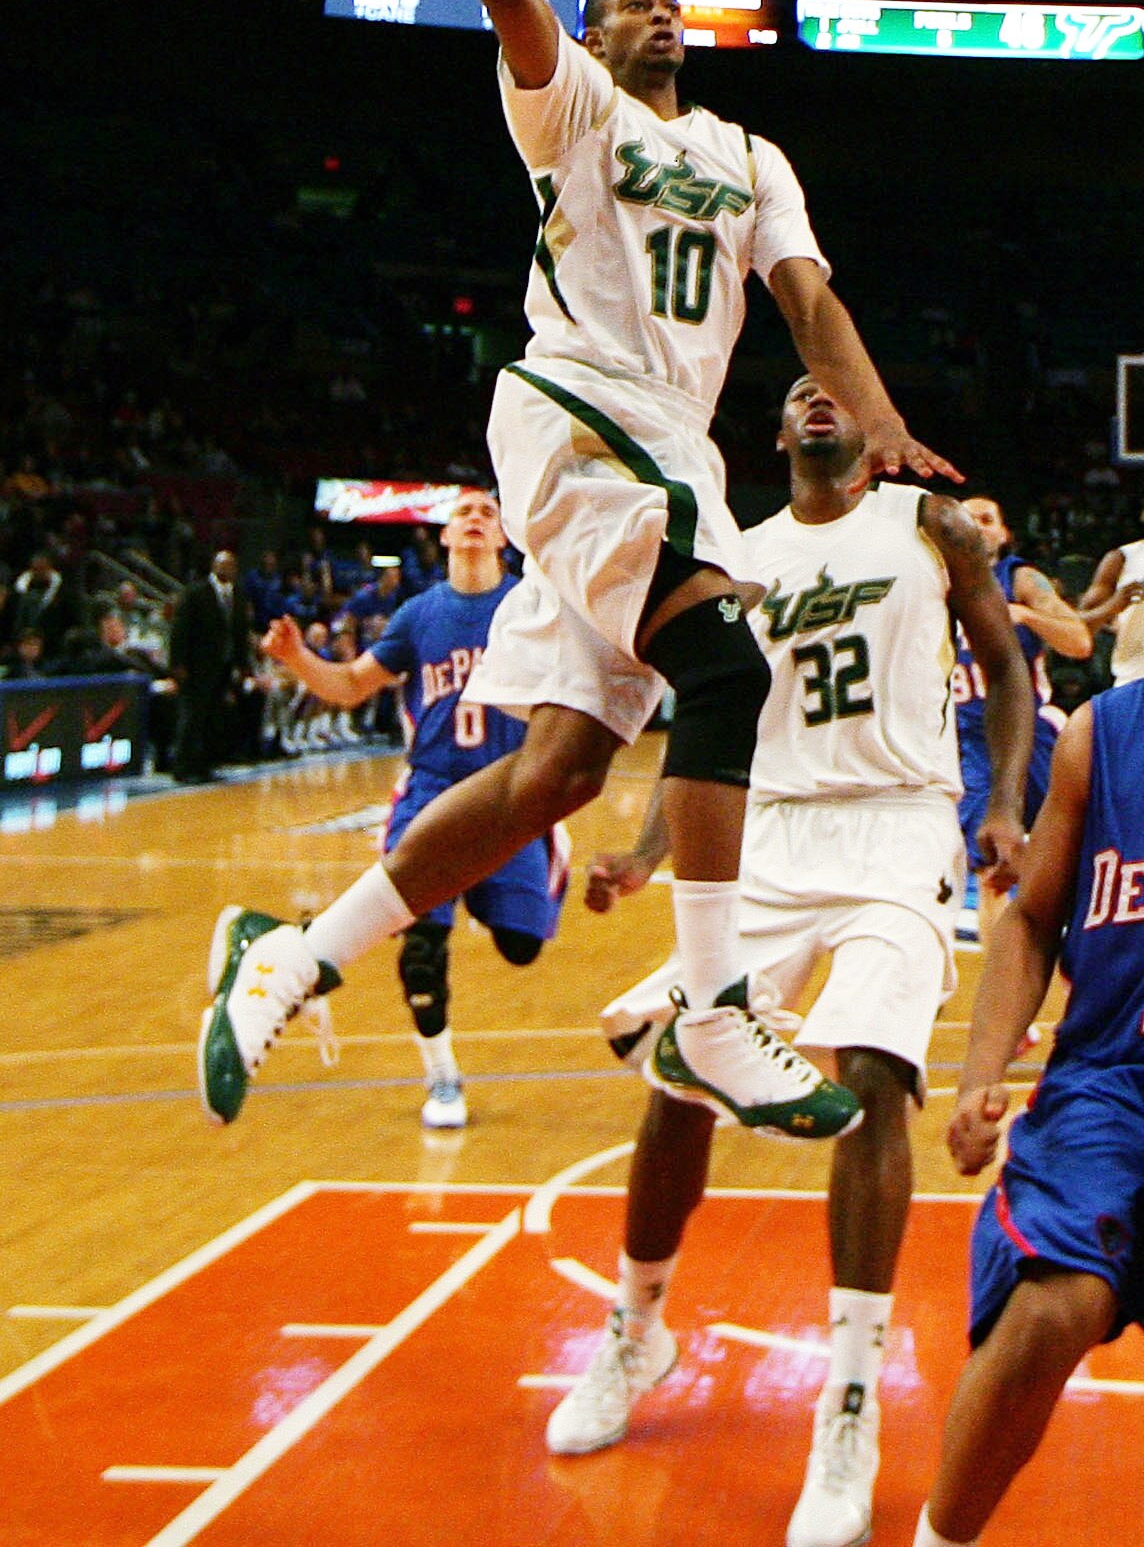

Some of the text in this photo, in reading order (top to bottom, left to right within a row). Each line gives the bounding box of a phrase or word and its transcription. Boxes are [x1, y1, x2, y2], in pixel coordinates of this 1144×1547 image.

[612, 135, 756, 222] USF
[644, 223, 716, 327] 10
[758, 562, 898, 643] USF
[420, 645, 484, 708] DEP
[791, 632, 876, 728] 32
[454, 701, 488, 749] 0
